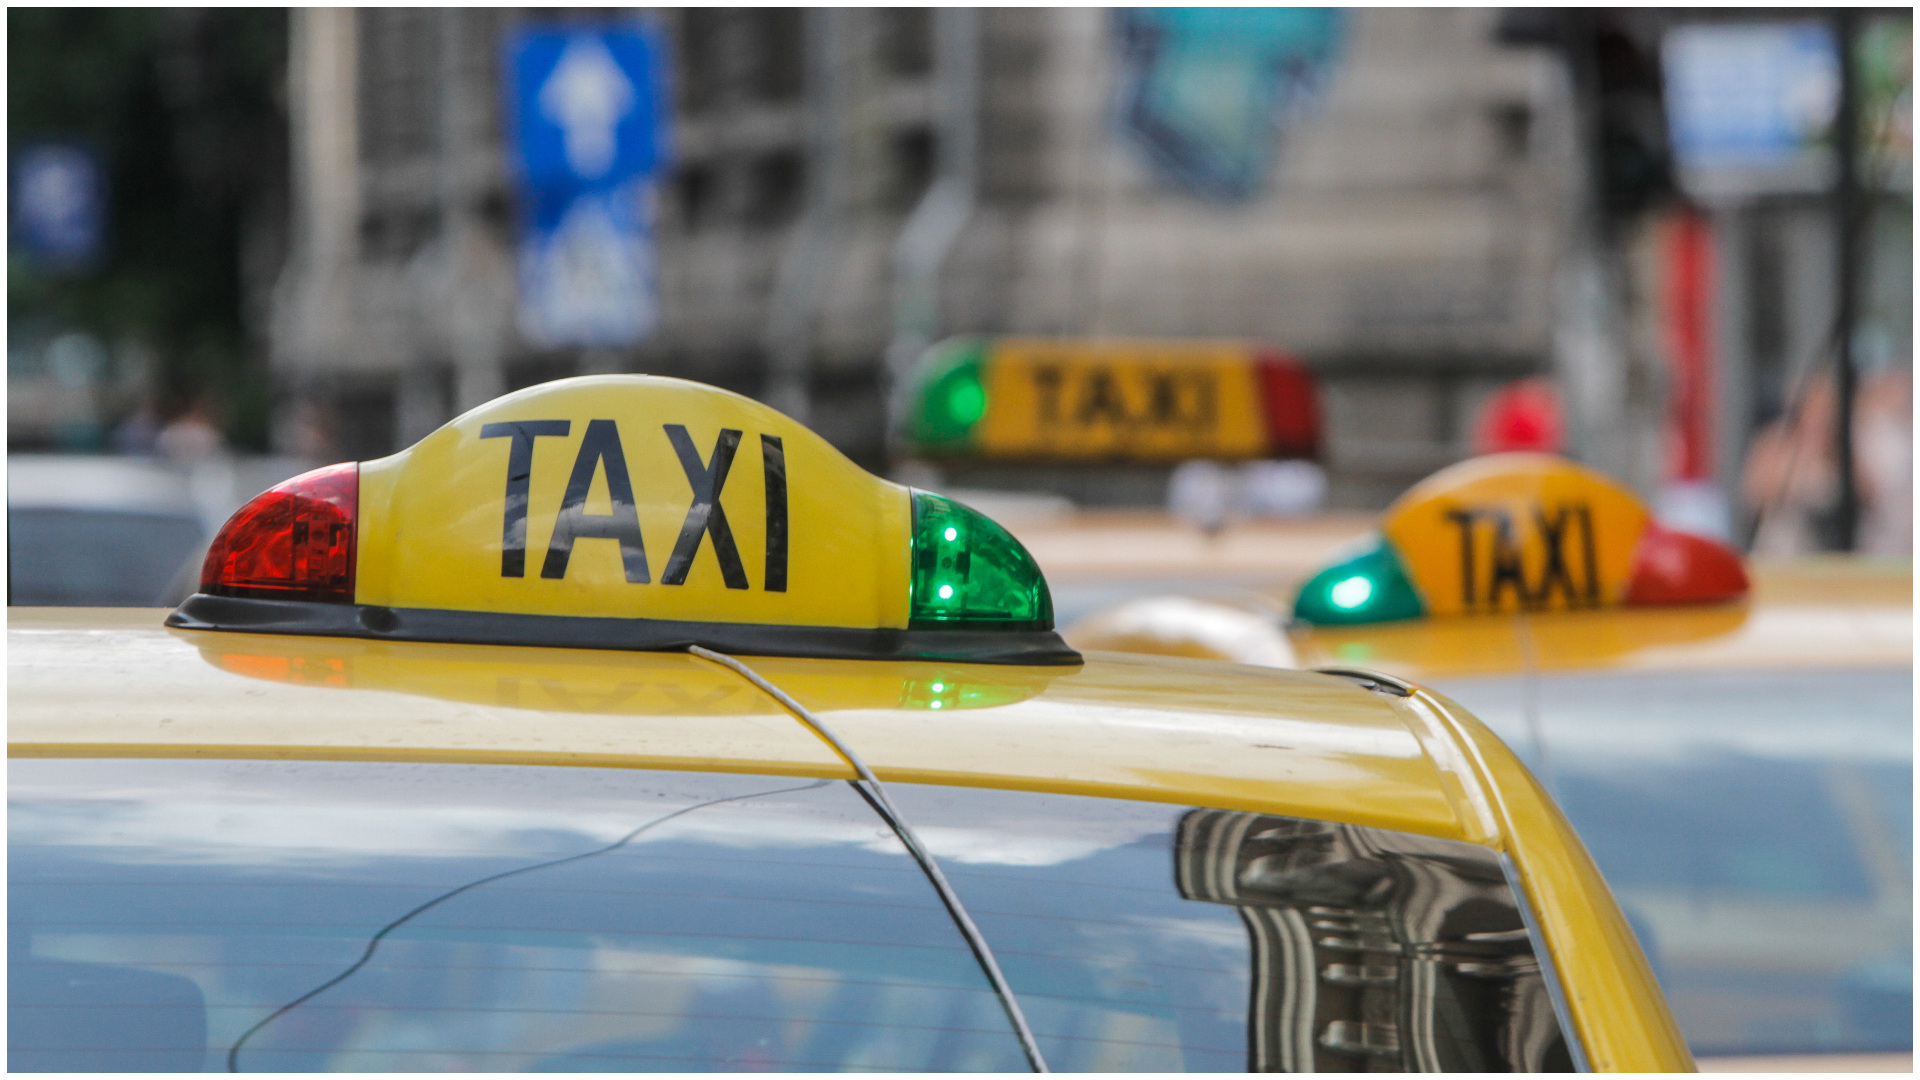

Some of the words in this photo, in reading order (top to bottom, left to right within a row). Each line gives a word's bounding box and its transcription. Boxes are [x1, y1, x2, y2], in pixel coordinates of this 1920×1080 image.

[1033, 363, 1219, 428] TAXI
[479, 419, 789, 593] TAXI
[1445, 507, 1600, 612] TAXI
